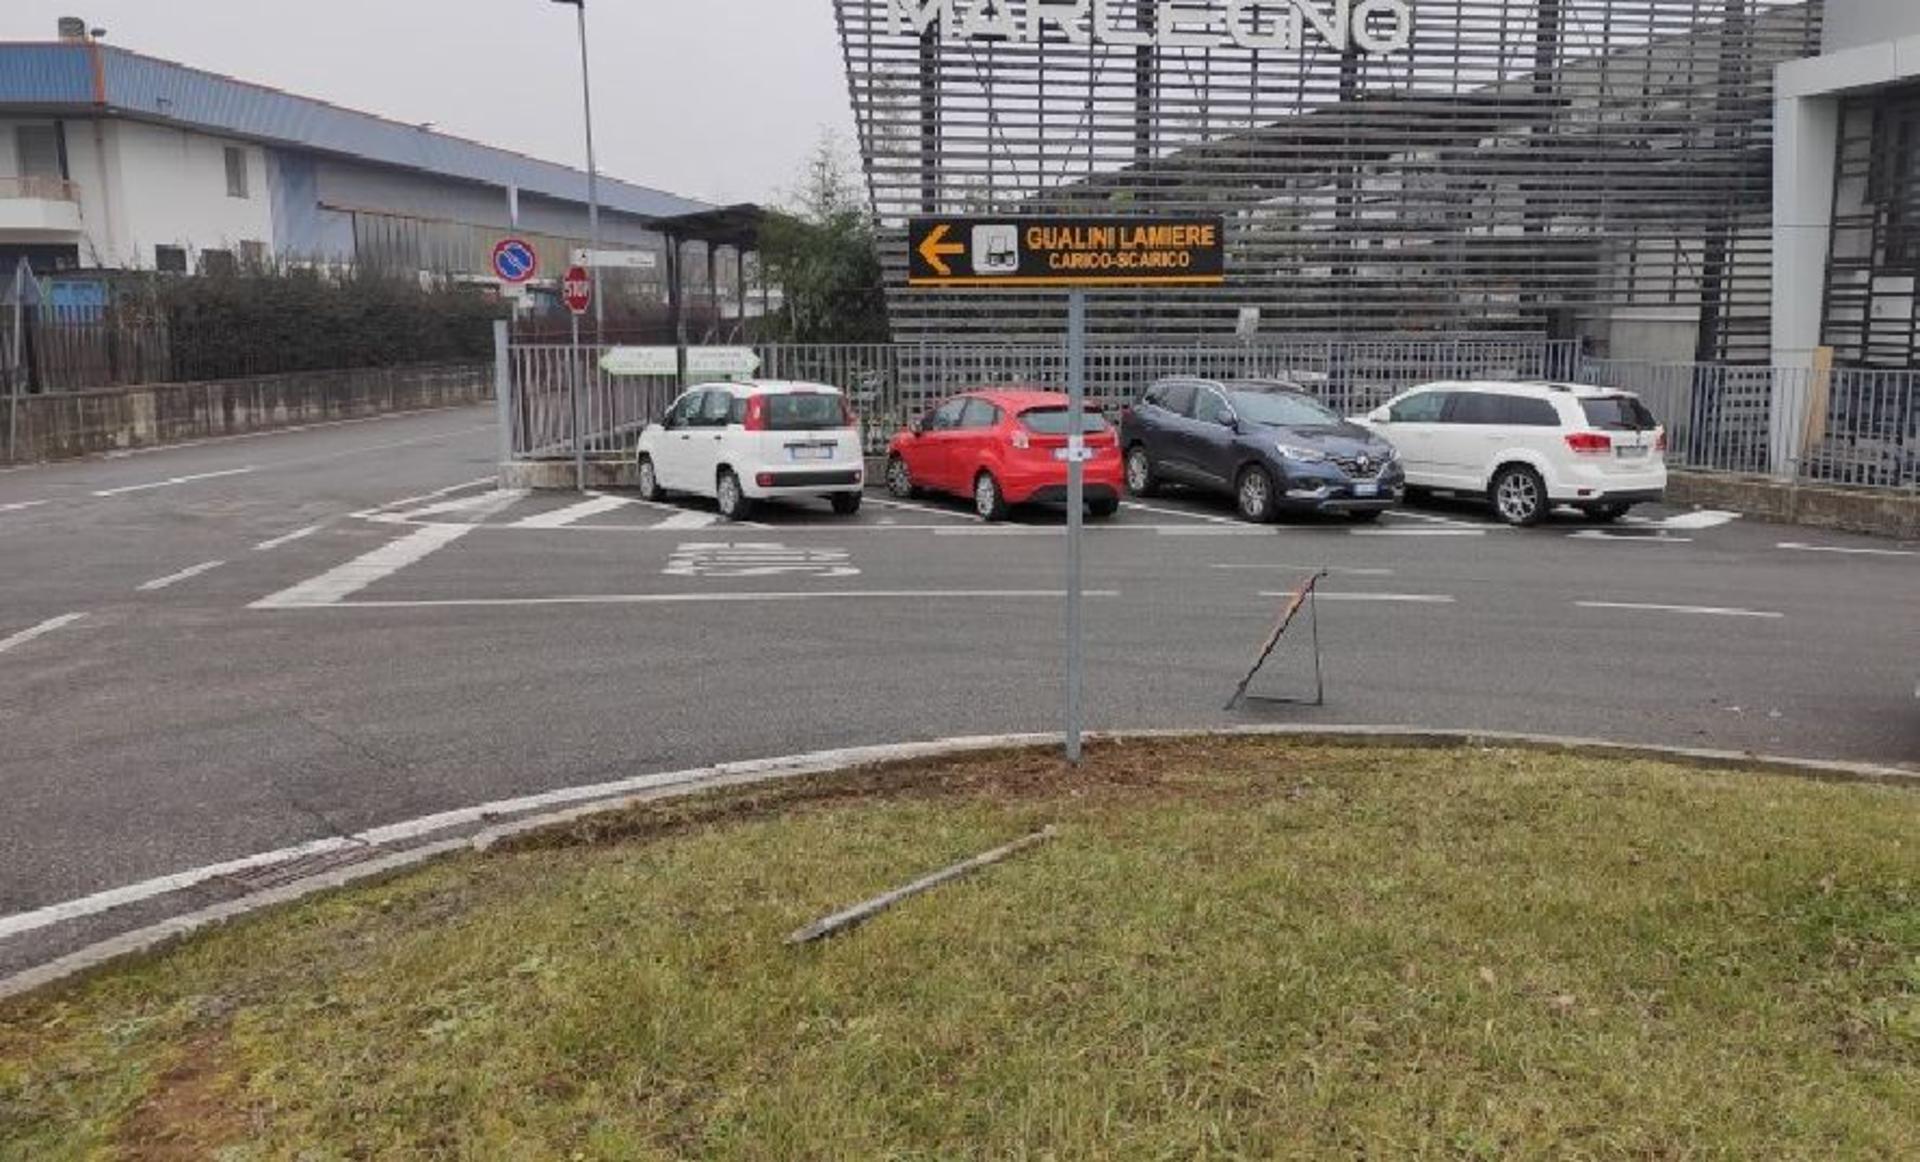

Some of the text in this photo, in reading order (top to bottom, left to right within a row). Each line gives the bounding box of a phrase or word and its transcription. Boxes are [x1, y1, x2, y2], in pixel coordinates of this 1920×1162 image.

[1027, 225, 1216, 249] GUALINI LAMIERE
[1049, 251, 1191, 269] CARICO-SCARICO
[563, 279, 592, 298] STOP
